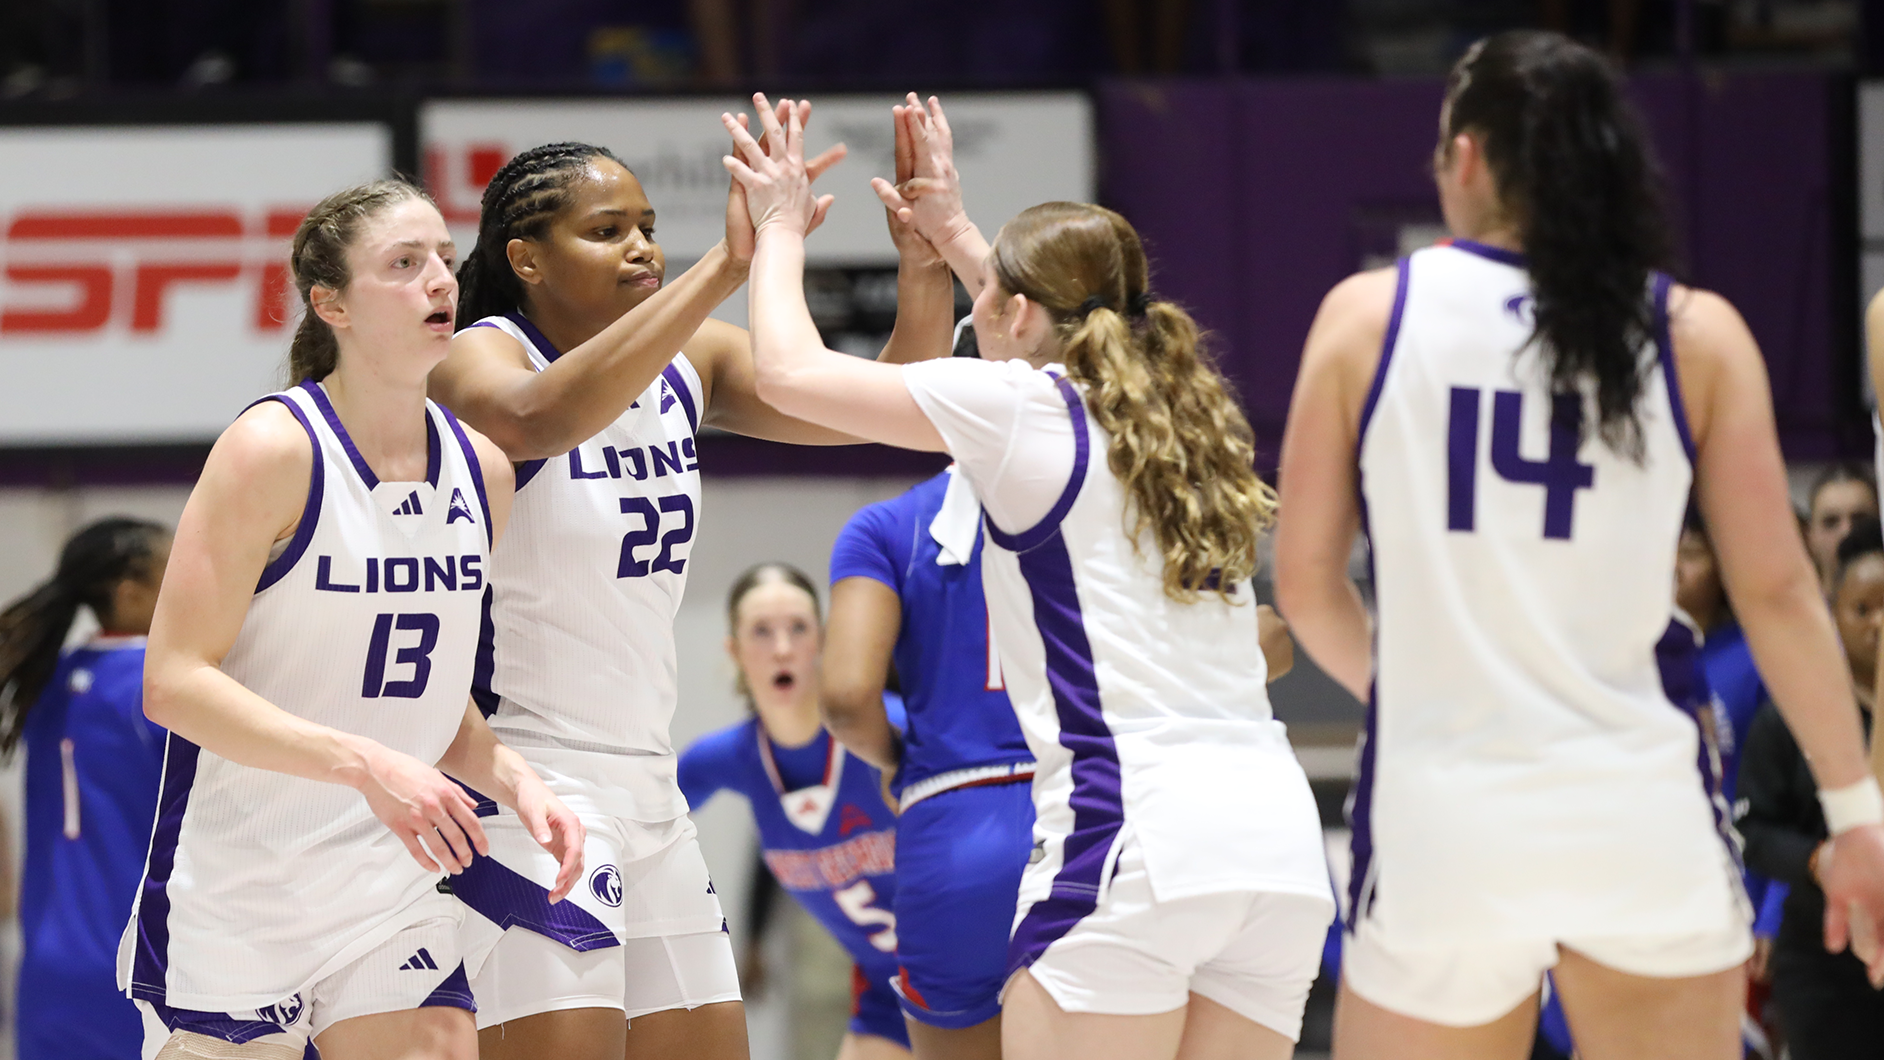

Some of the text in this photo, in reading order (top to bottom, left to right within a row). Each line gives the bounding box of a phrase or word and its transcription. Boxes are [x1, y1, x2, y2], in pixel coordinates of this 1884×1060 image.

[1447, 386, 1595, 540] 14
[315, 554, 482, 594] LIONS
[617, 493, 694, 579] 22
[361, 612, 441, 699] 13
[60, 738, 81, 841] 1
[833, 879, 898, 953] 5
